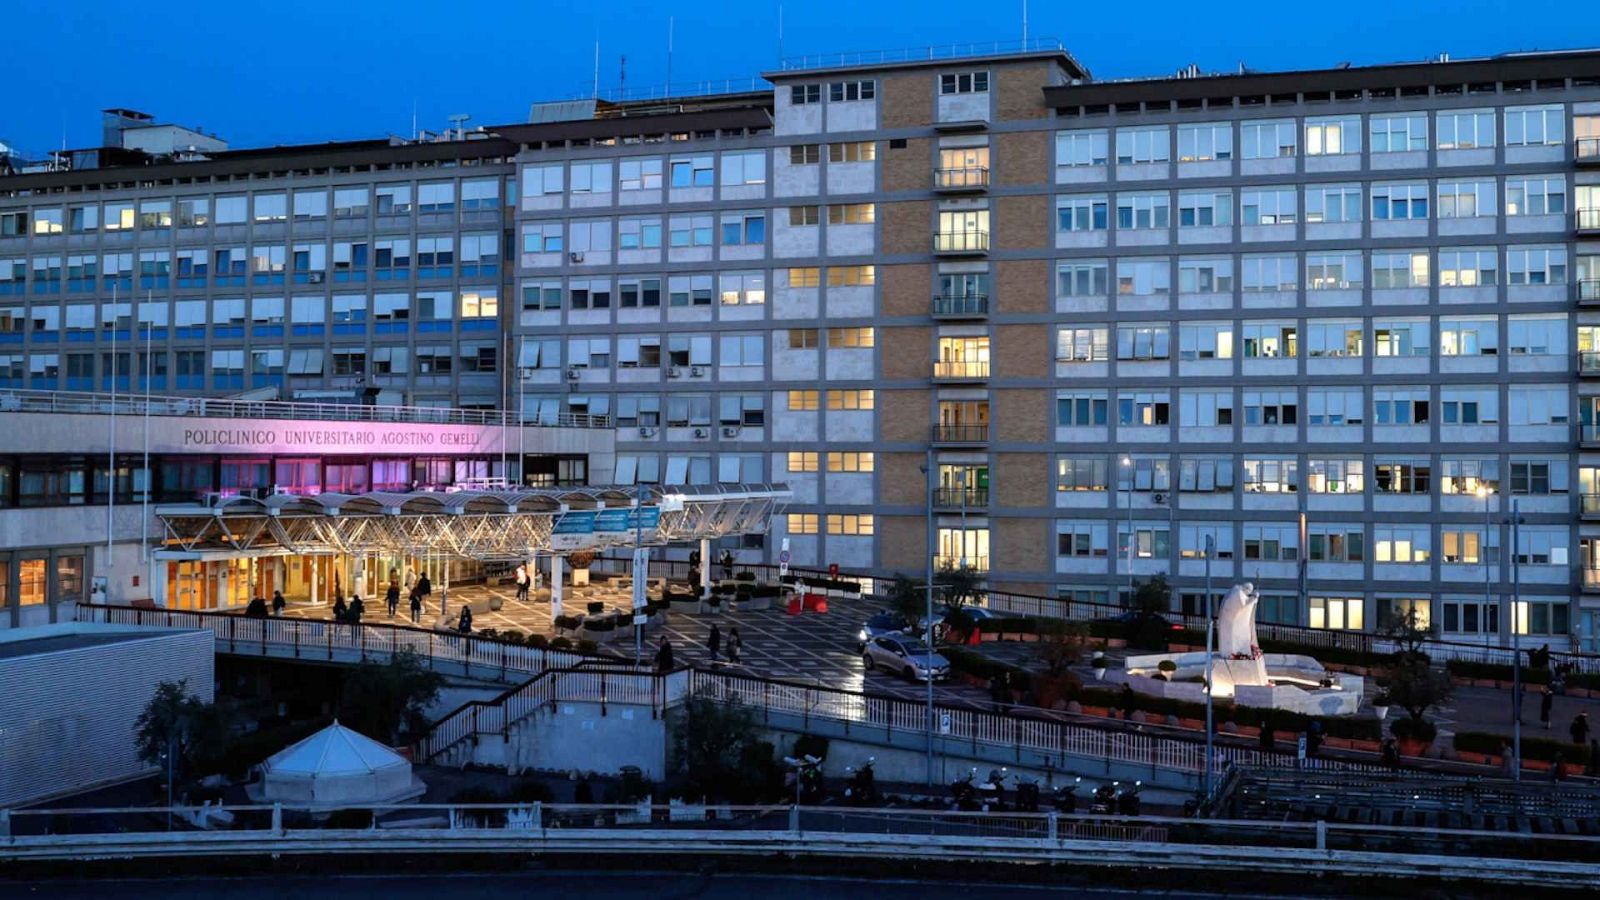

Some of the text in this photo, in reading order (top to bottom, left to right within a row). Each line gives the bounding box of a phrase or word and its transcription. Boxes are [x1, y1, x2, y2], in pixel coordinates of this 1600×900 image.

[184, 429, 480, 446] POLICLINICO UNIVERSITARIO AGOSTINO GEMELLI
